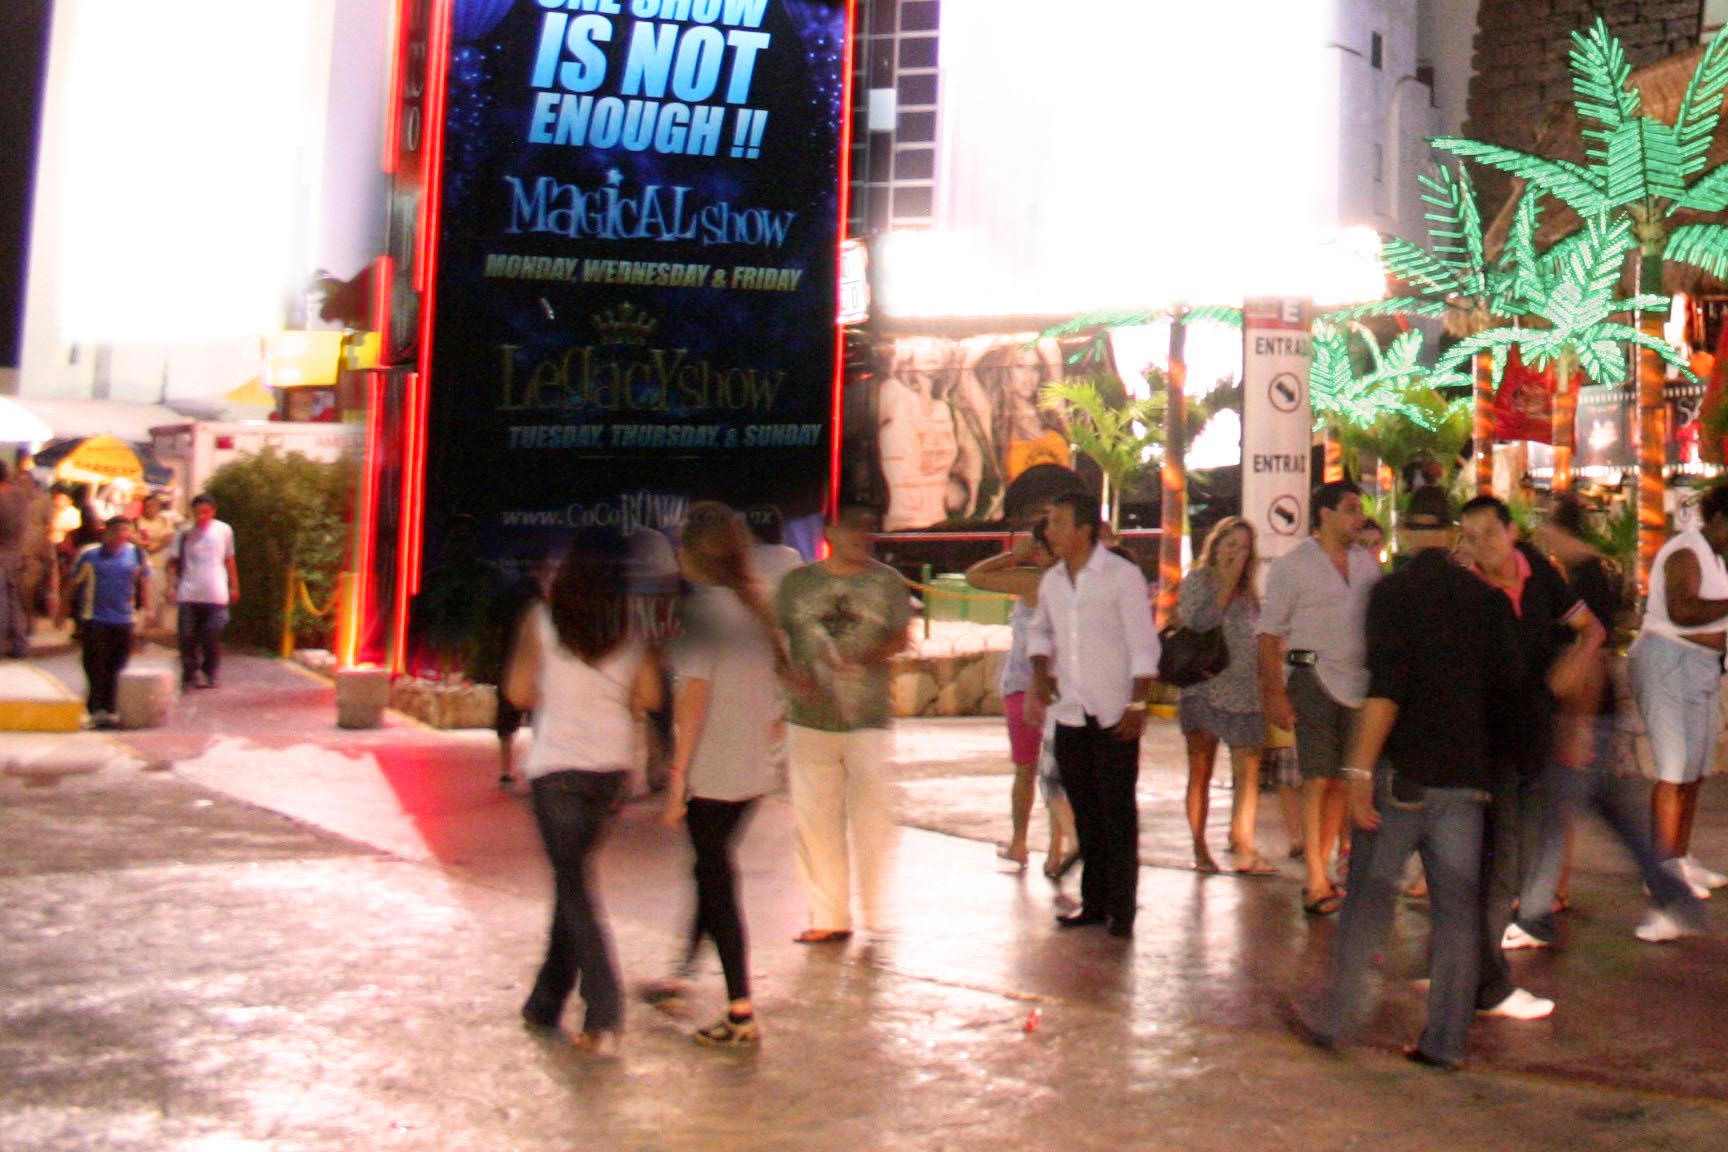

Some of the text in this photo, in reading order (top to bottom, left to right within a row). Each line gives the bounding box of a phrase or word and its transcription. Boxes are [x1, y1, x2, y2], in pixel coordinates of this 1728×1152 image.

[531, 12, 771, 105] IS NOT
[528, 92, 726, 159] ENOUGH
[700, 201, 797, 248] show
[582, 259, 712, 288] WEDNESDAY
[710, 268, 728, 289] &
[730, 265, 804, 293] FRIDAY
[742, 422, 824, 448] SUNDAY
